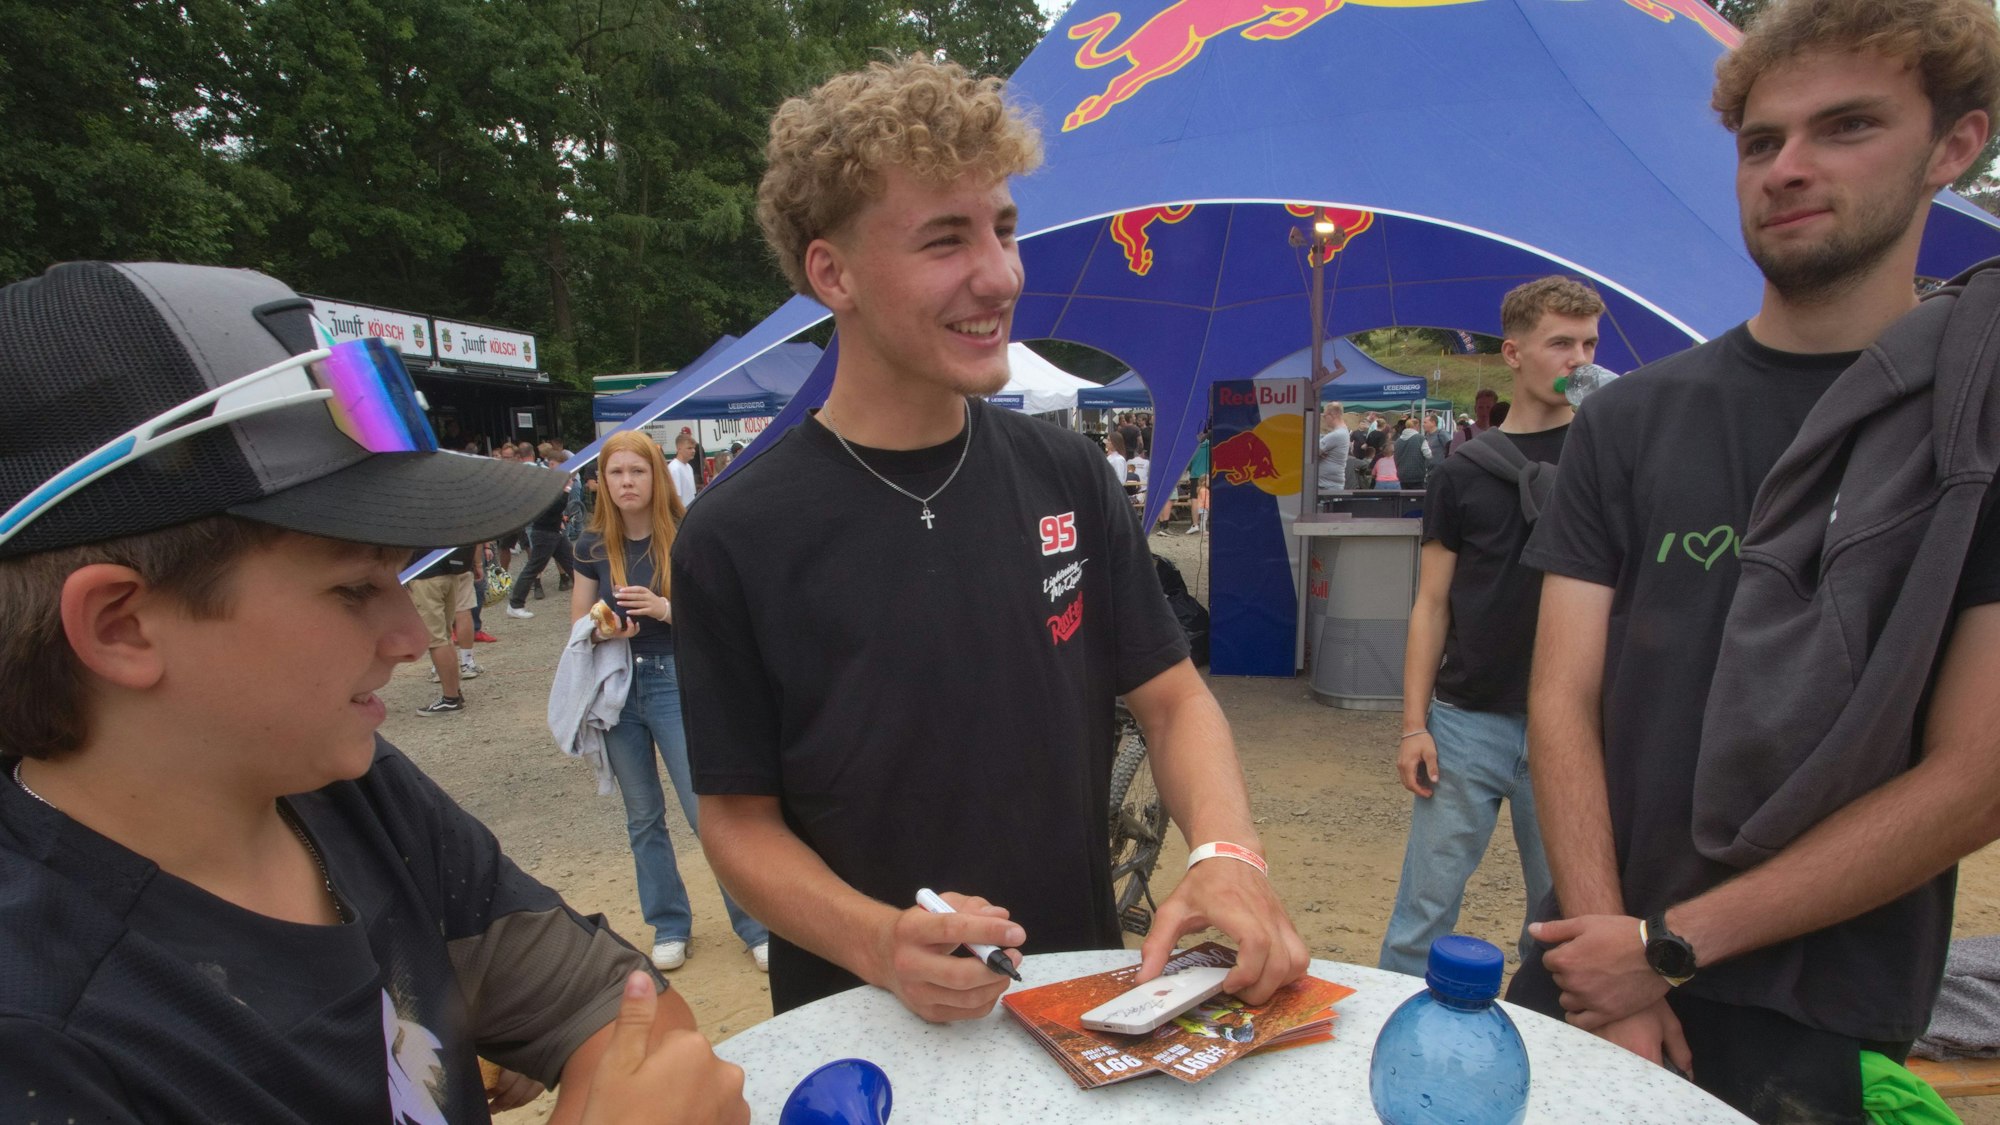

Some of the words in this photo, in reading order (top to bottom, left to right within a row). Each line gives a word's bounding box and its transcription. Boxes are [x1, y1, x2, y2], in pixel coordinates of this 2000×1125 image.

[328, 310, 364, 338] Zunft
[368, 318, 404, 341] KÖLSCH
[460, 331, 487, 355] Zunft
[490, 338, 517, 356] KÖLSCH
[1219, 385, 1258, 406] Red
[1260, 384, 1297, 404] Bull
[1383, 383, 1421, 391] UEBERBERG
[727, 401, 766, 409] UEBERBERG
[1040, 511, 1077, 556] 95
[1656, 532, 1676, 563] I
[1094, 1054, 1143, 1076] 991
[1173, 1044, 1227, 1076] #991
